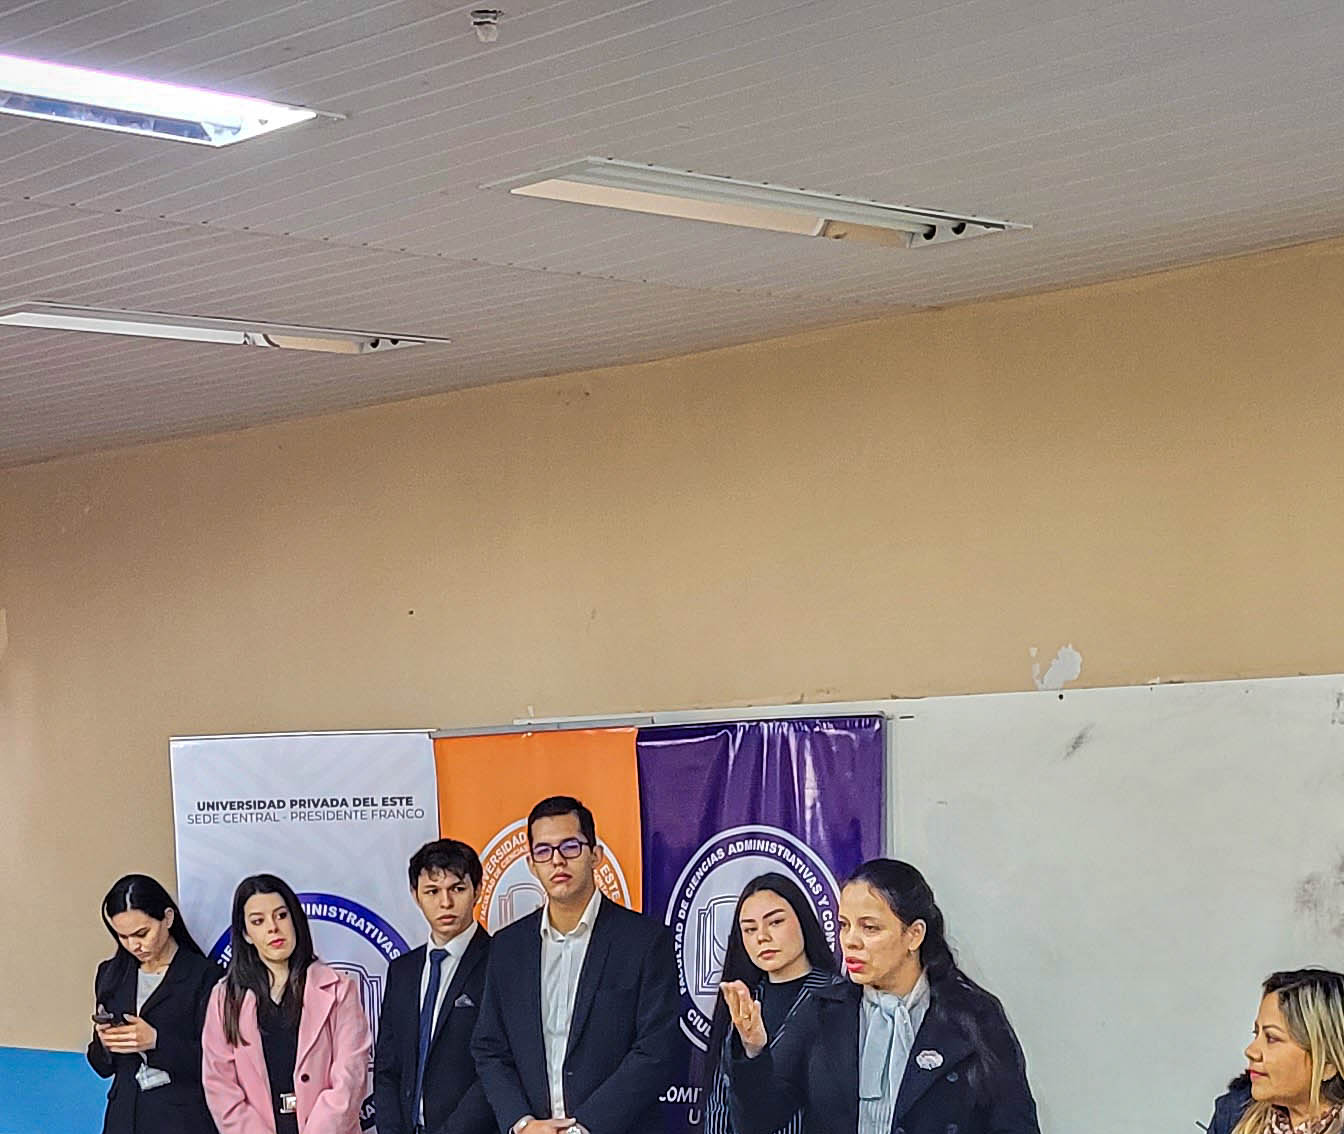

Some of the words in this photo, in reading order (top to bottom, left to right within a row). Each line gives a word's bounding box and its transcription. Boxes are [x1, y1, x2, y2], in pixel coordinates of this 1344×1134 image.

[187, 813, 220, 825] SEDE
[223, 811, 280, 824] CENTRAL
[290, 809, 368, 822] PRESIDENTE
[371, 807, 425, 820] FRANCO
[197, 799, 286, 812] UNIVERSIDAD
[289, 797, 349, 809] PRIVADA
[352, 797, 378, 808] DEL
[382, 796, 414, 807] ESTE
[678, 900, 689, 920] DE
[685, 847, 725, 898] CIENCIAS
[727, 839, 823, 895] ADMINISTRATIVAS
[818, 894, 830, 906] Y
[301, 903, 401, 960] INISTRATIVAS
